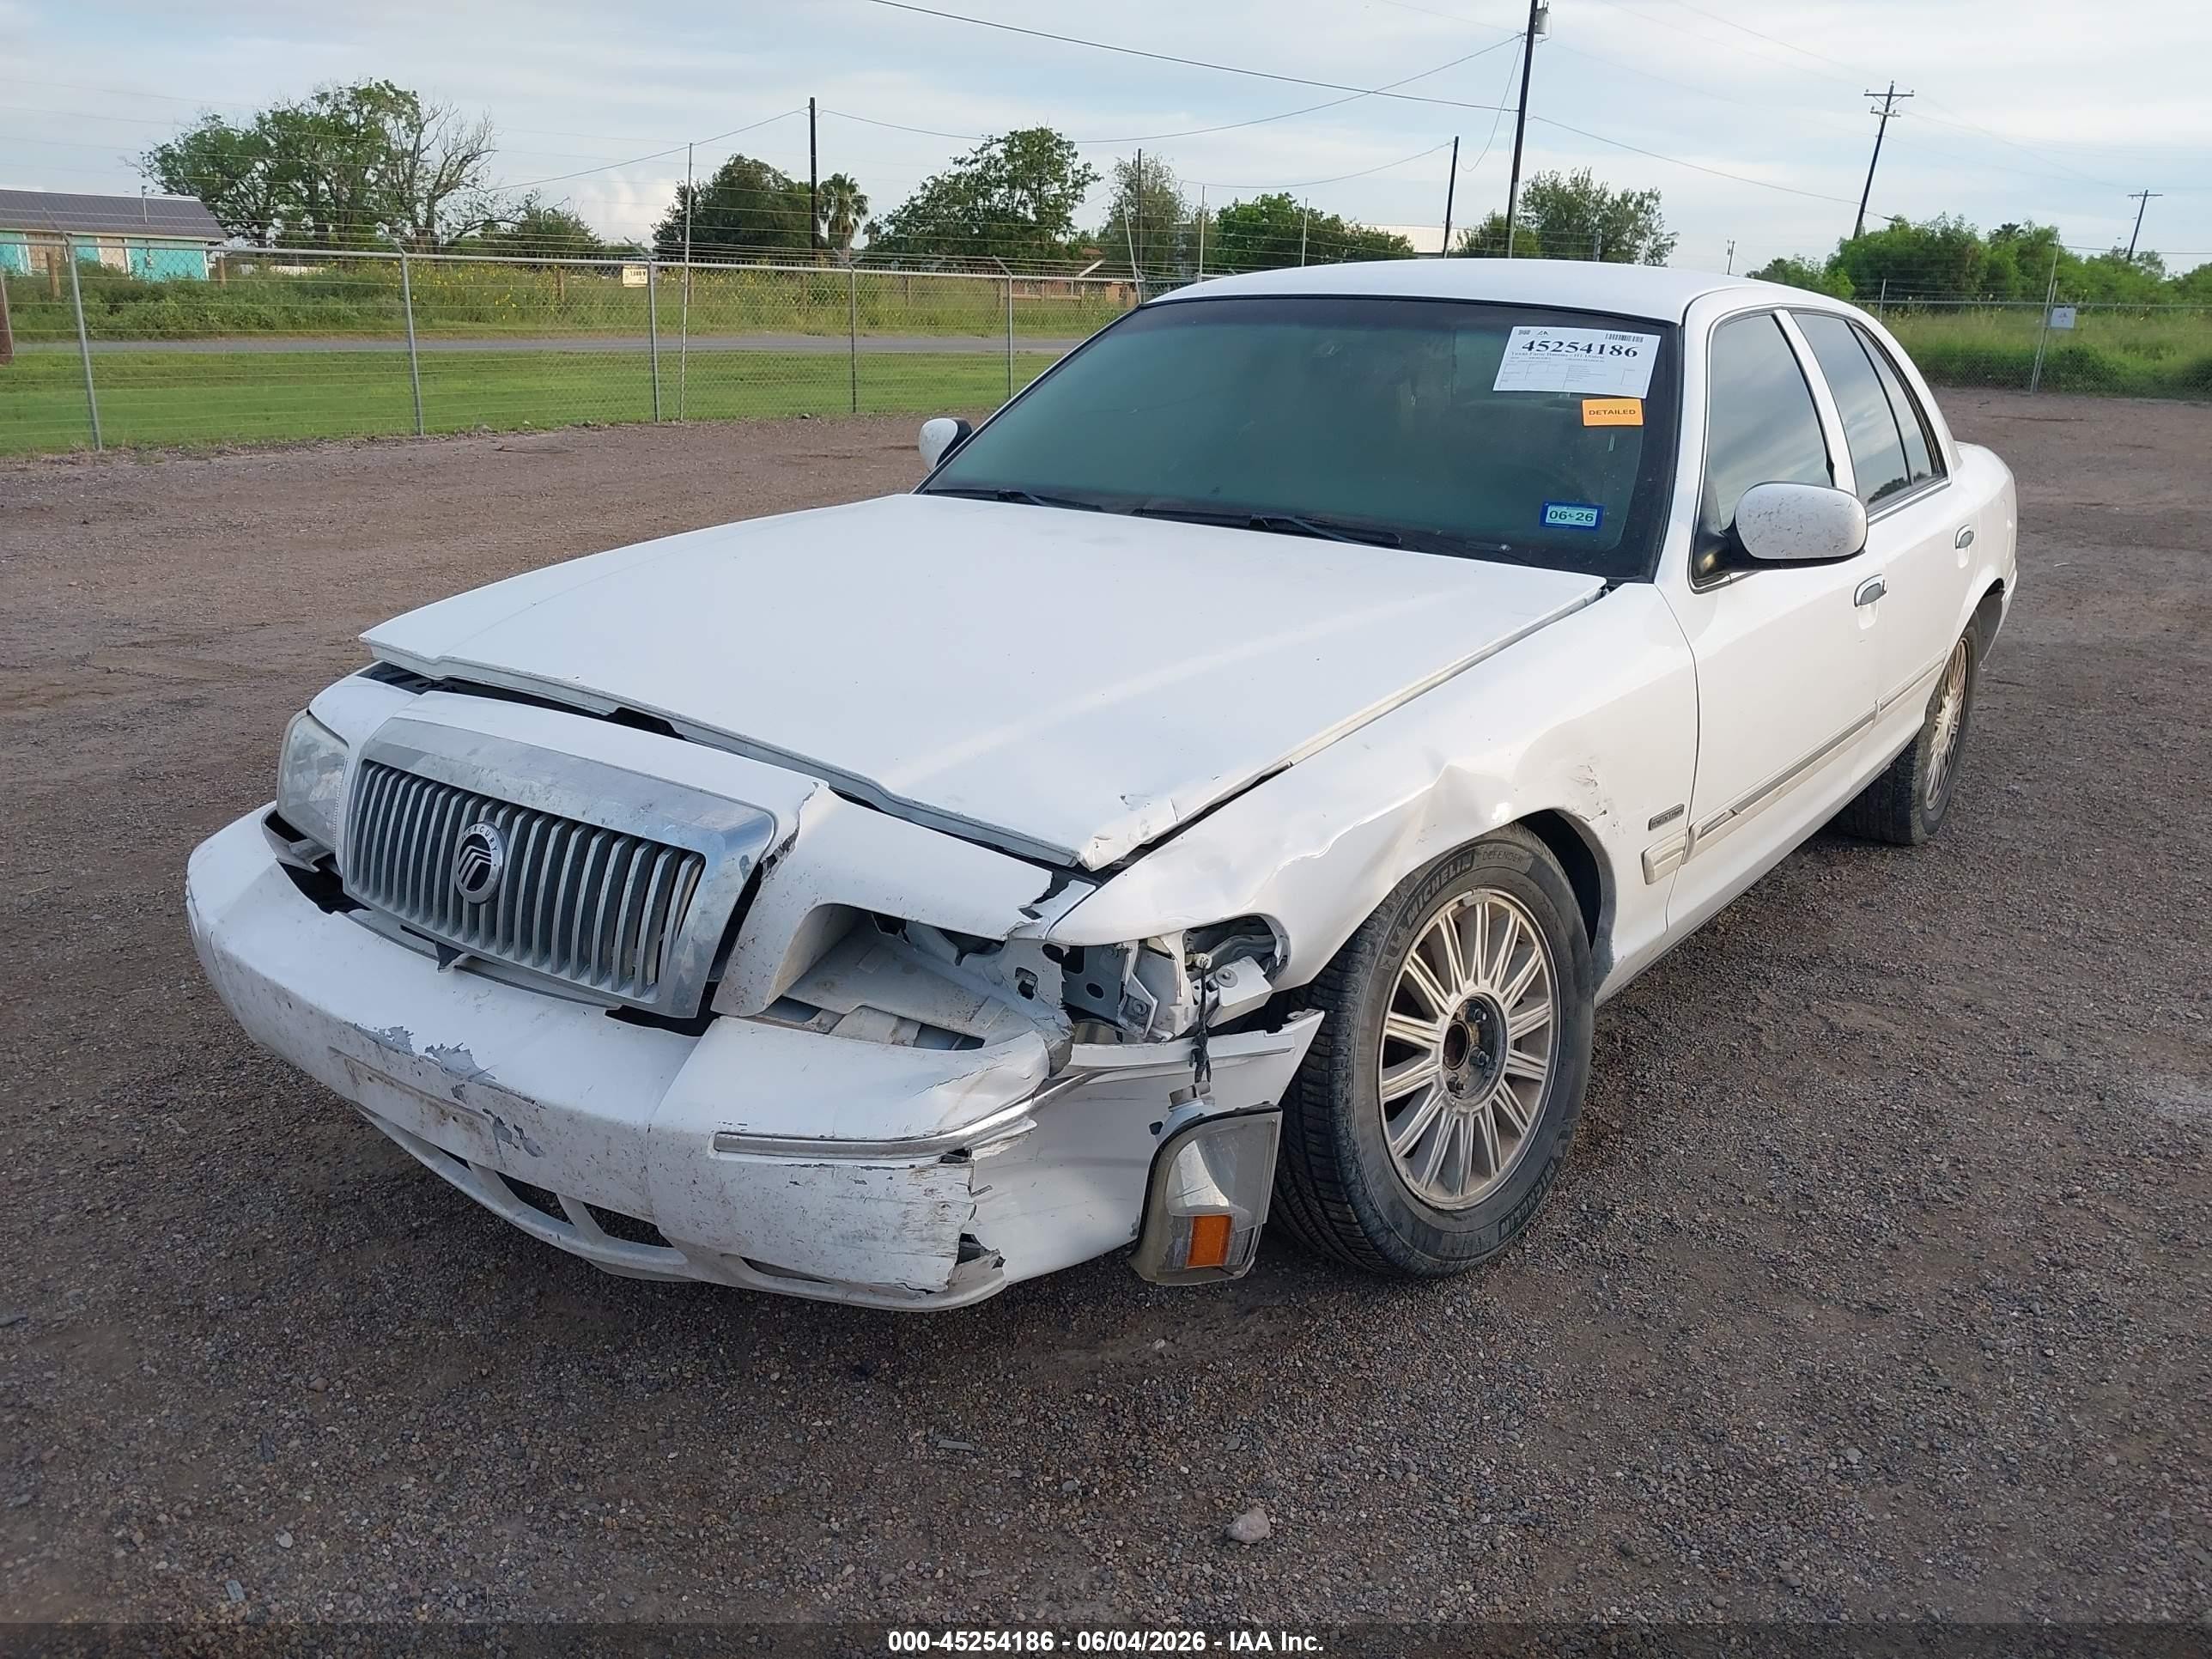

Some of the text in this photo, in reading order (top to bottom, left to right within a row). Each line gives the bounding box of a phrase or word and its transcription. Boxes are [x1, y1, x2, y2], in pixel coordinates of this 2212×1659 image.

[1522, 339, 1641, 359] 45254186
[1588, 408, 1637, 416] DETAILED
[460, 825, 498, 852] MERCURY
[1407, 849, 1523, 926] MICHELIN DEFENDER
